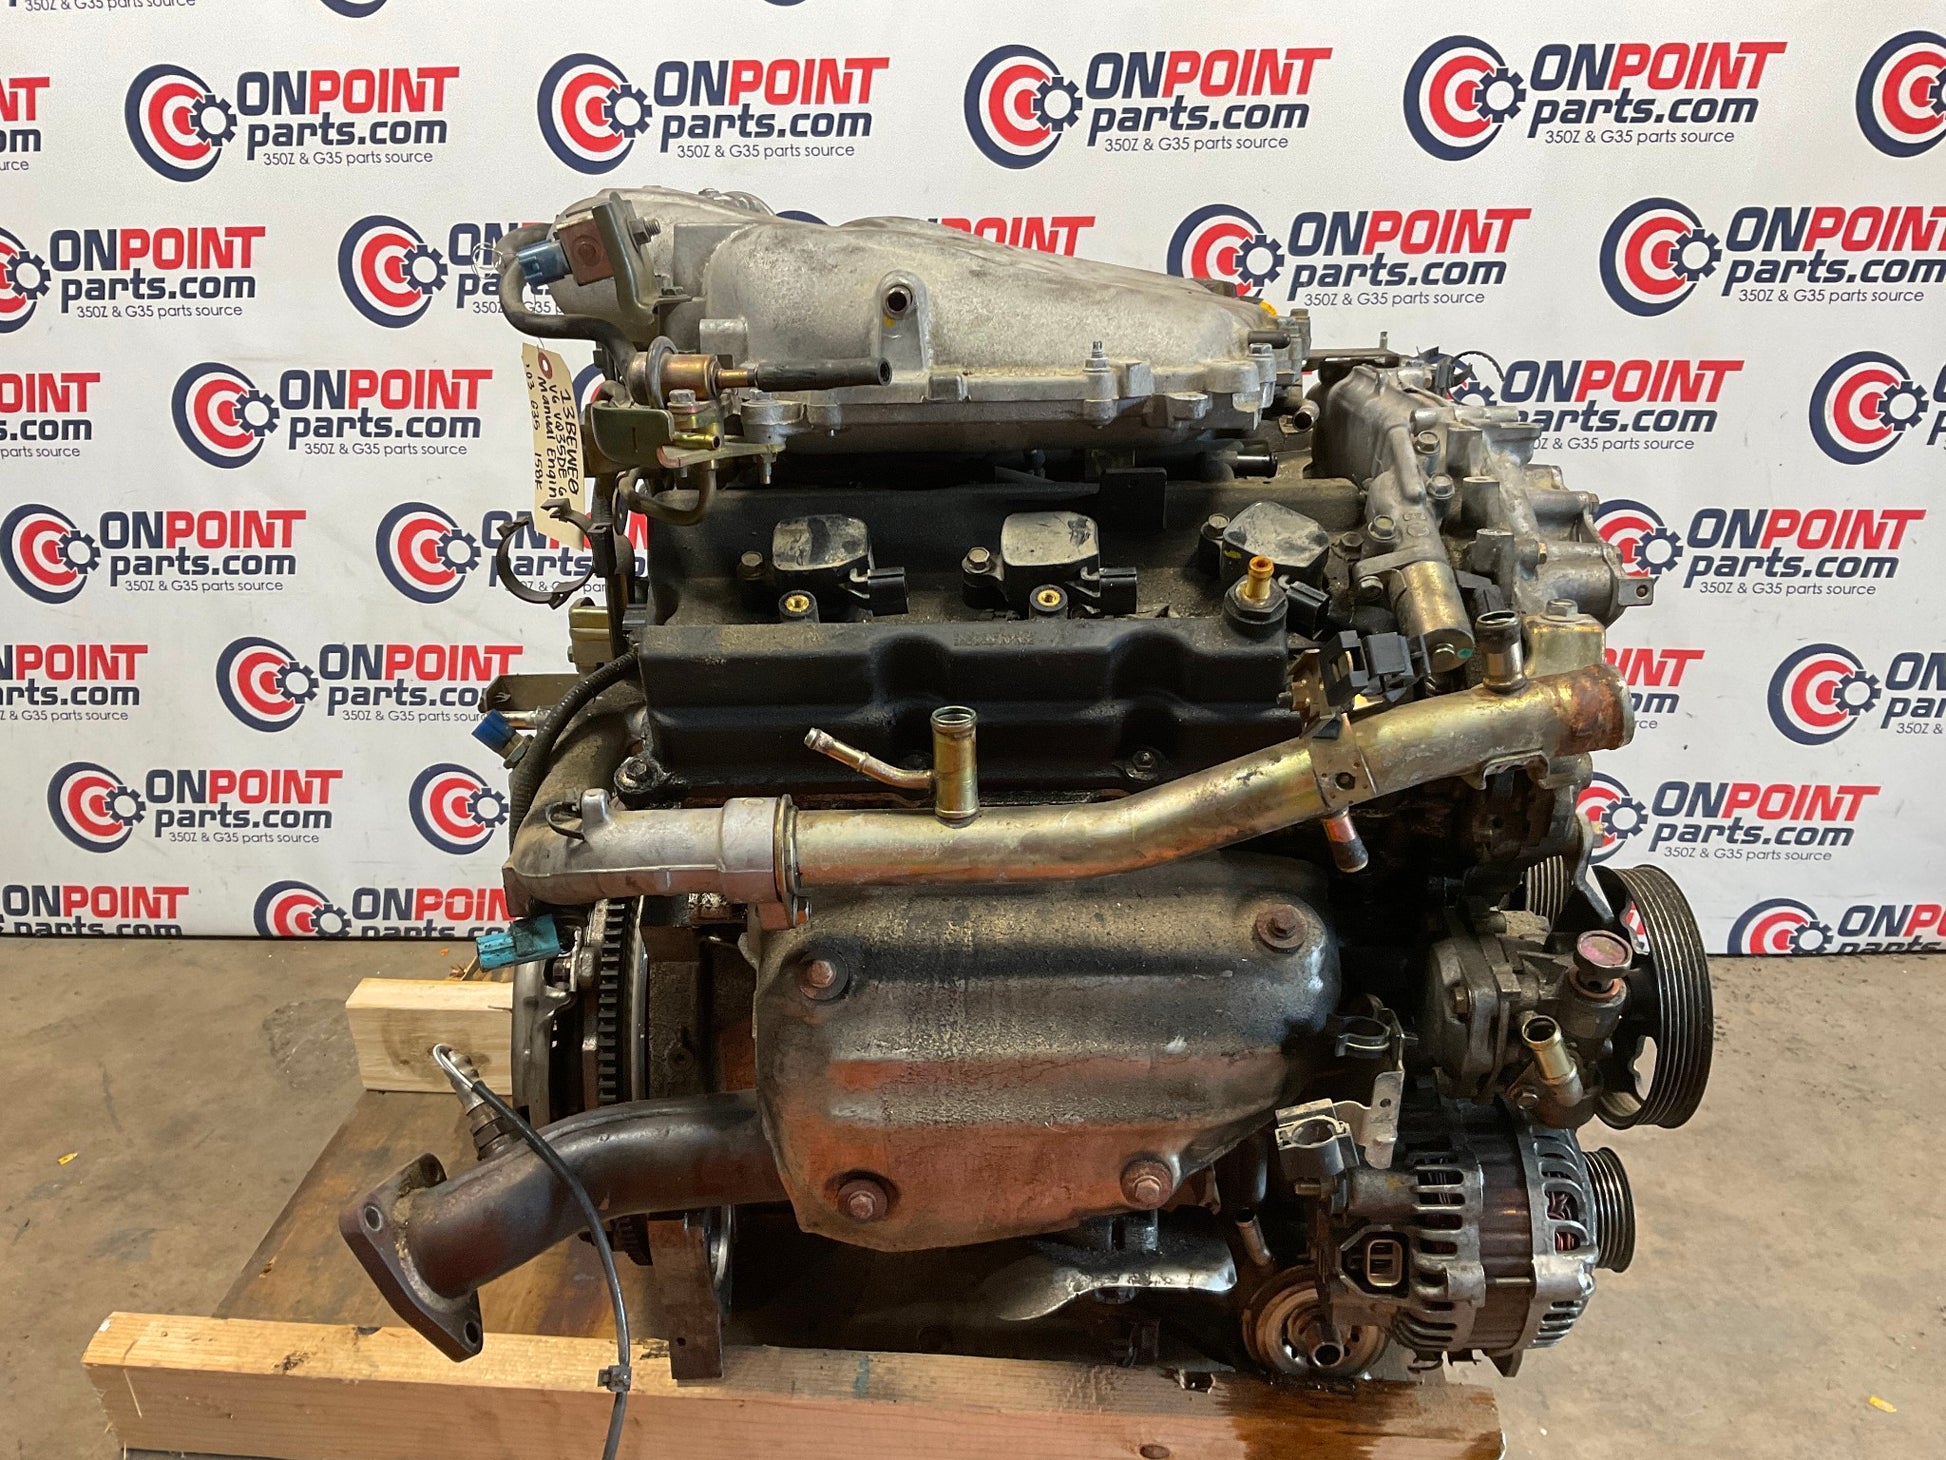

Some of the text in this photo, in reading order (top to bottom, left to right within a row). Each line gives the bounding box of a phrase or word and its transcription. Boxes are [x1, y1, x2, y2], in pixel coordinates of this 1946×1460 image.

[654, 57, 890, 107] ONPOINT
[1086, 47, 1333, 100] ONPOINT
[1530, 42, 1788, 91] ONPOINT
[237, 66, 460, 116] ONPOINT
[660, 103, 872, 153] parts.com
[1087, 95, 1309, 147] parts.com
[1527, 87, 1759, 138] parts.com
[247, 112, 447, 161] parts.com
[677, 144, 854, 160] 350Z & G35 parts source
[1105, 136, 1288, 152] 350Z & G35 parts source
[1545, 129, 1734, 146] 350Z & G35 parts source
[263, 151, 433, 166] 350Z & G35 parts source
[50, 226, 266, 272] ONPOINT
[1288, 208, 1532, 257] ONPOINT
[61, 268, 255, 313] parts.com
[1287, 252, 1507, 301] parts.com
[77, 305, 242, 319] 350Z & G35 parts source
[1304, 291, 1485, 307] 350Z & G35 parts source
[1739, 289, 1924, 304] 350Z & G35 parts source
[0, 372, 100, 413] OINT
[279, 369, 493, 410] ONPOINT
[1501, 360, 1745, 402] ONPOINT
[538, 376, 556, 440] Manual
[289, 407, 481, 450] parts.com
[1552, 438, 1563, 449] &
[1568, 437, 1598, 449] G35
[1602, 437, 1640, 452] parts
[1643, 440, 1694, 449] source
[0, 446, 80, 459] parts source
[305, 443, 467, 457] 350Z & G35 parts source
[100, 510, 306, 549] ONPOINT
[1687, 508, 1927, 550] ONPOINT
[110, 546, 296, 587] parts.com
[1683, 547, 1899, 588] parts.com
[125, 580, 283, 593] 350Z & G35 parts source
[1700, 582, 1876, 596] 350Z & G35 parts source
[0, 644, 148, 681] POINT
[319, 643, 523, 681] ONPOINT
[0, 678, 139, 706] rts.com
[327, 678, 486, 716] parts.co
[9, 711, 18, 720] &
[22, 710, 47, 720] G35
[51, 710, 83, 722] parts
[85, 712, 128, 720] source
[343, 710, 371, 720] 350Z
[375, 711, 385, 721] &
[388, 711, 415, 721] G35
[418, 711, 450, 723] parts
[1896, 722, 1943, 734] 350Z &
[145, 769, 343, 804] ONPOINT
[1652, 781, 1881, 821] ONPOINT
[155, 802, 332, 838] parts.com
[169, 832, 319, 844] 350Z & G35 parts source
[1648, 817, 1854, 852] parts.com
[1664, 847, 1832, 861] 350Z & G35 parts source
[2, 885, 189, 919] ONPOINT
[352, 887, 515, 921] ONPOIN
